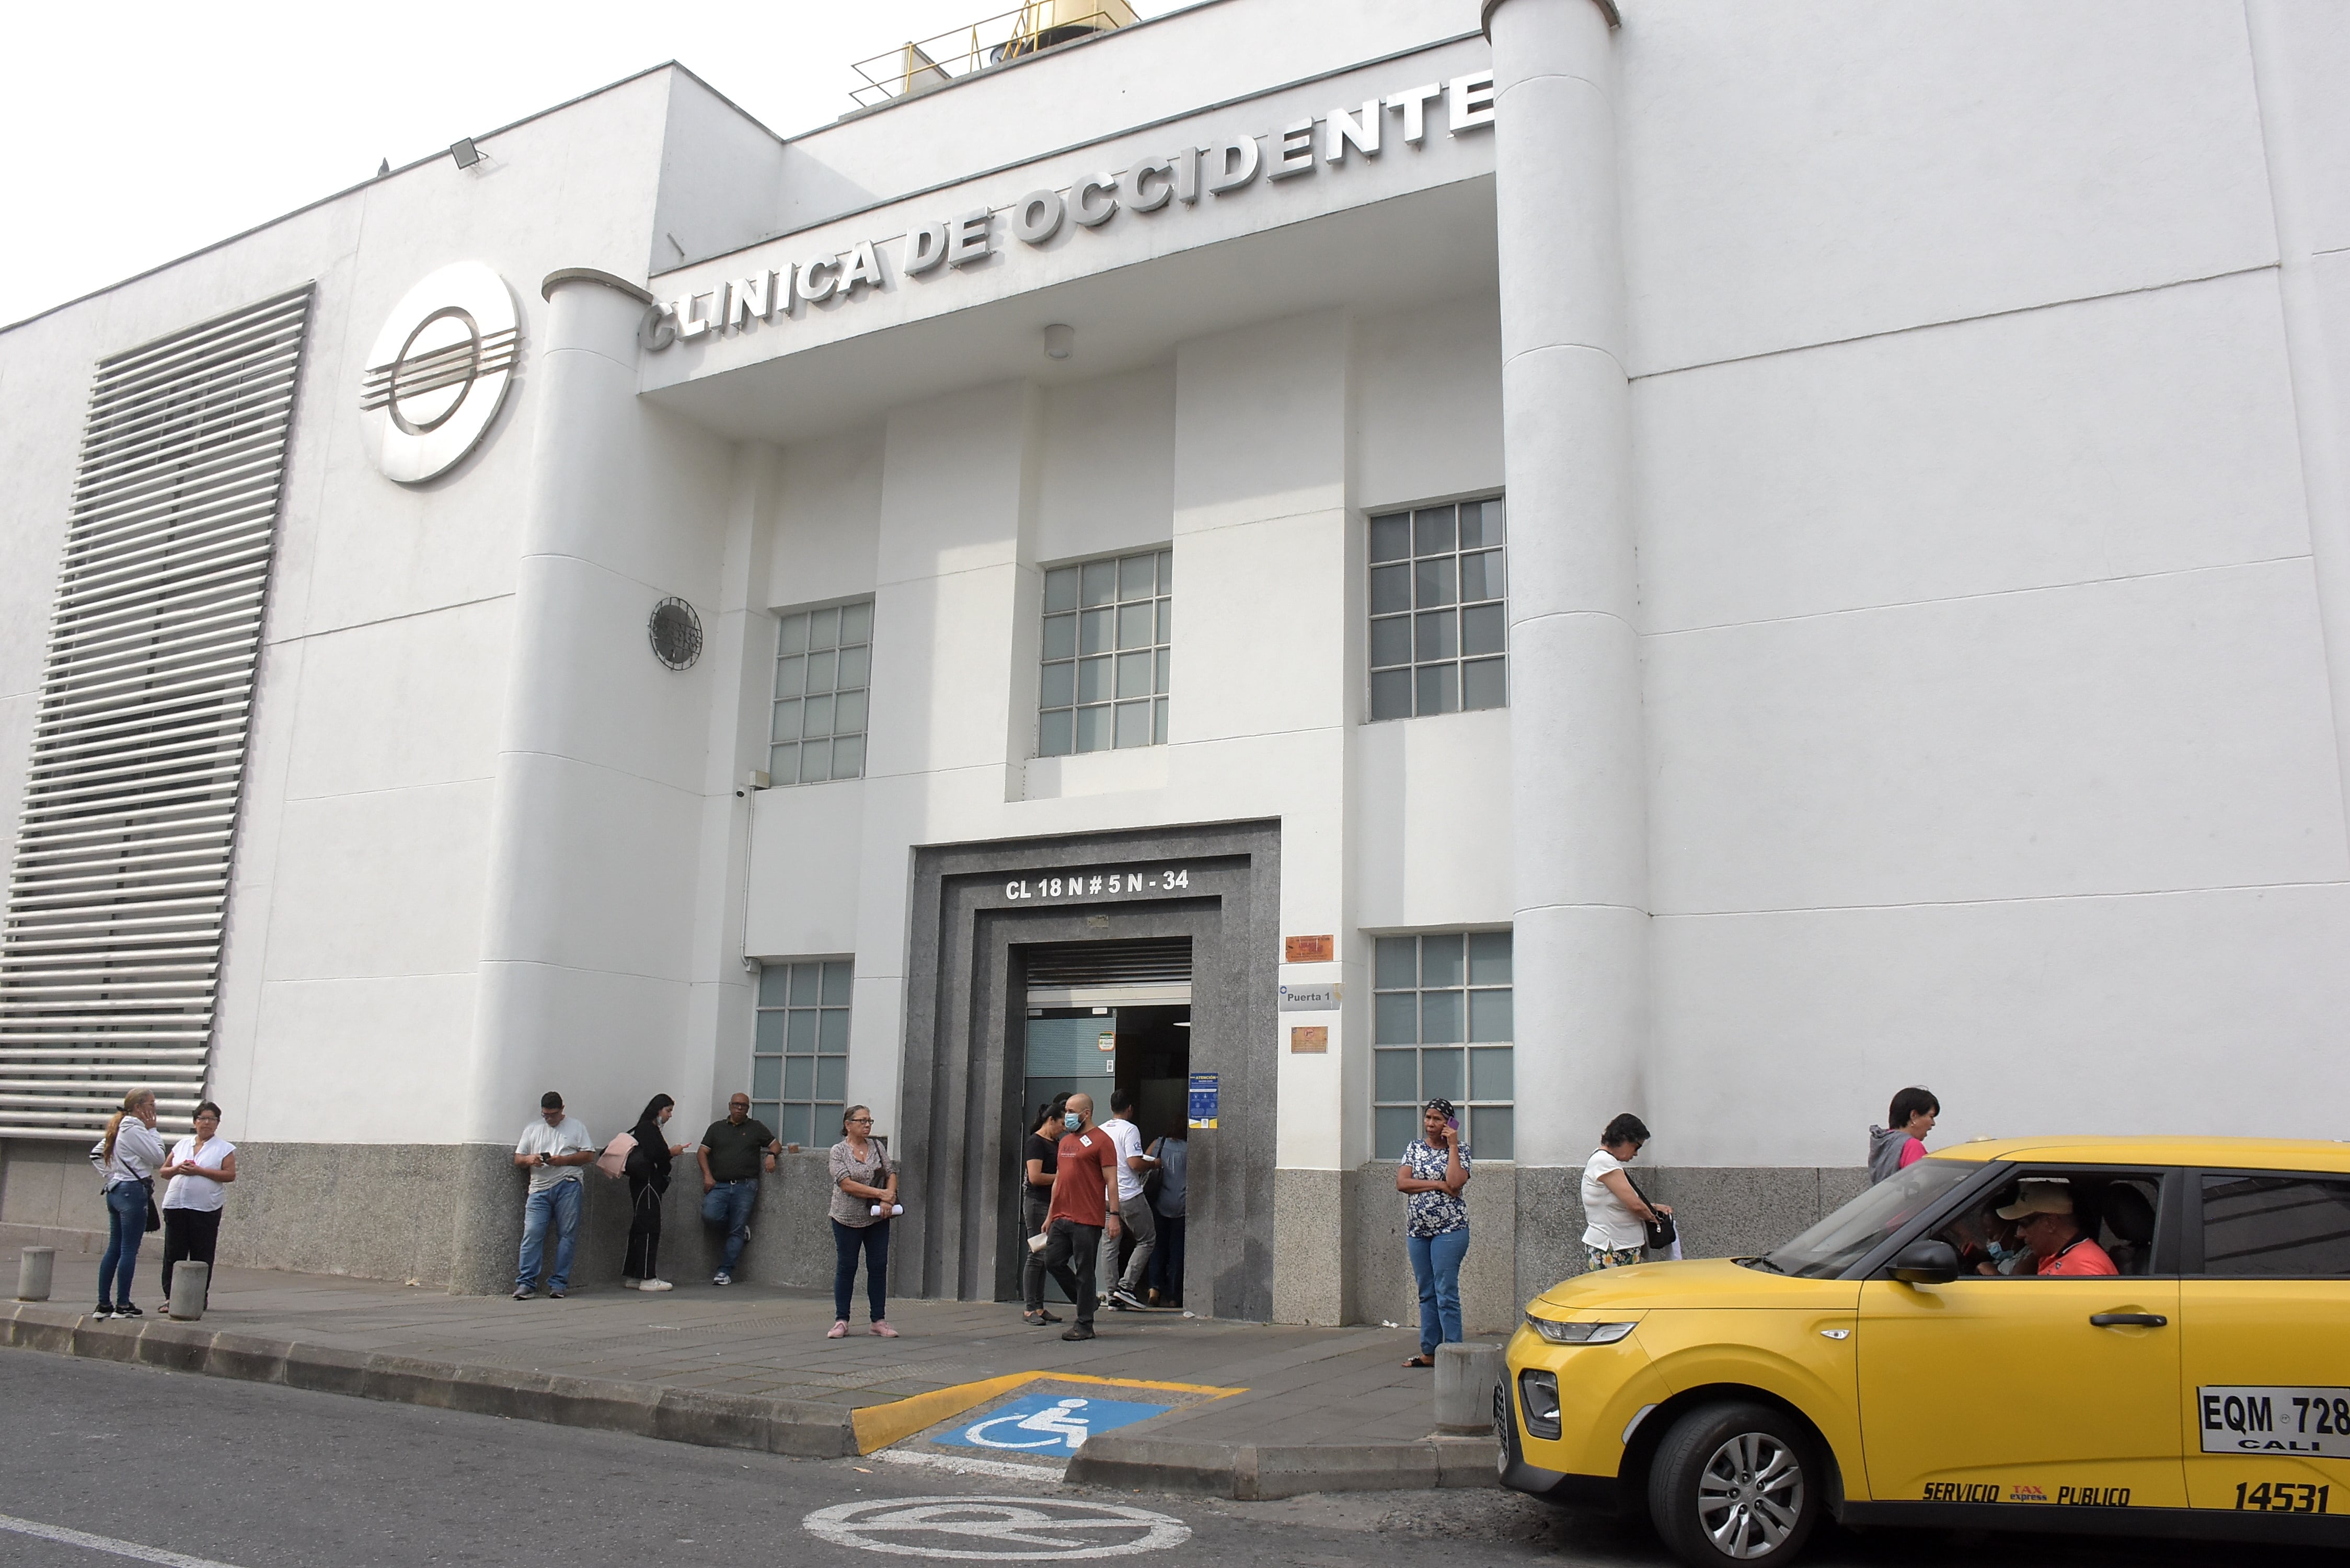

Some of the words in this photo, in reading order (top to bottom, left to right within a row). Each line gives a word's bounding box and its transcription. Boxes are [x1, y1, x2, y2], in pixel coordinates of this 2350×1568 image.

[638, 239, 885, 352] CLINICA
[904, 205, 997, 277] DE
[1011, 68, 1494, 244] OCCIDENTE
[1006, 881, 1031, 900] CL
[1038, 878, 1062, 897] 18
[1068, 877, 1082, 896] N
[1090, 875, 1102, 894] #
[1108, 874, 1121, 893] 5
[1127, 873, 1143, 892] N
[1162, 870, 1189, 890] 34
[1287, 993, 1321, 1001] Puerta
[2203, 1395, 2273, 1436] EQM
[2292, 1398, 2350, 1435] 728
[2238, 1439, 2320, 1451] CALI
[1922, 1482, 2000, 1502] SERVICIO
[2057, 1485, 2130, 1507] PUBLICO
[2010, 1493, 2047, 1502] express
[2012, 1485, 2043, 1494] TAX
[2236, 1482, 2330, 1513] 14531
